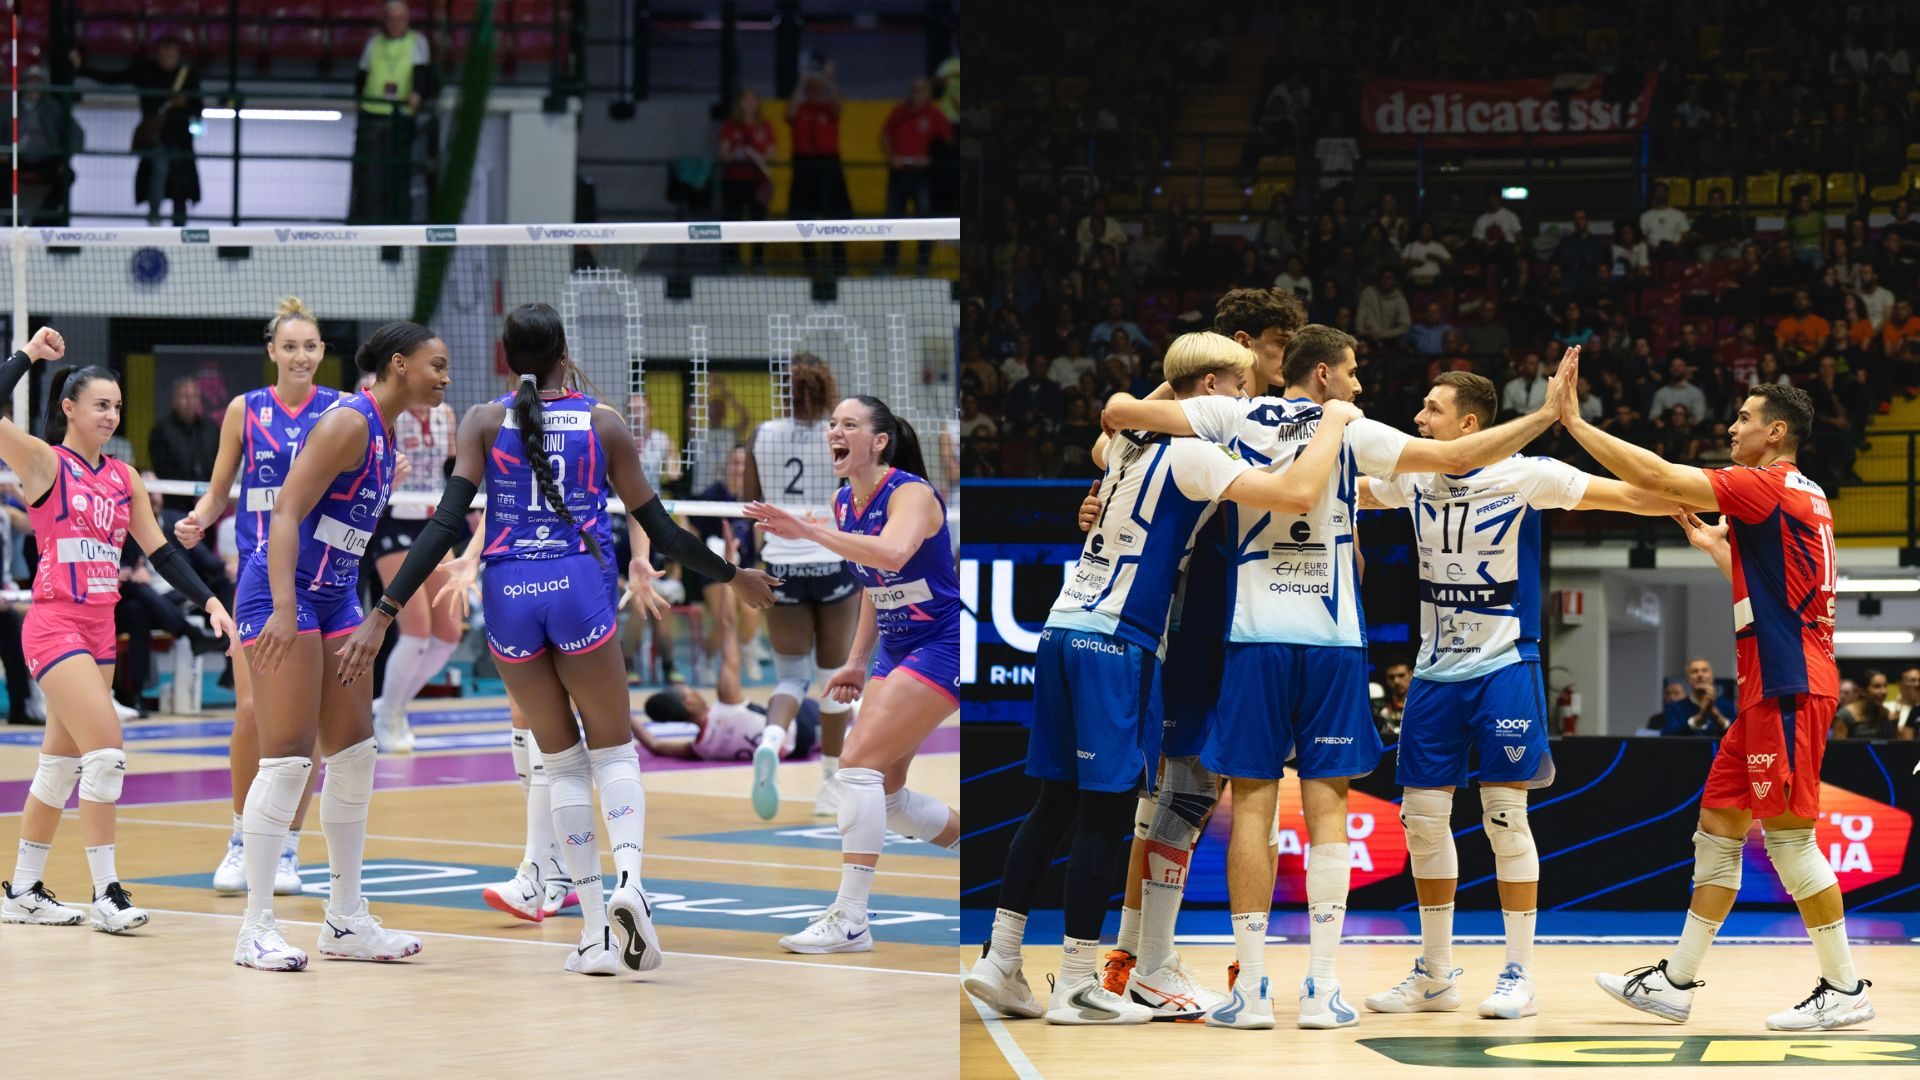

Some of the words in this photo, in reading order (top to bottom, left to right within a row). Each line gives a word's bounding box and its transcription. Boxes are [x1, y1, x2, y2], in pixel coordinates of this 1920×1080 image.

[542, 413, 578, 425] umia
[542, 433, 565, 452] ONU
[783, 457, 805, 495] 2
[93, 495, 115, 531] 80
[1475, 494, 1516, 516] FREDDY
[1441, 502, 1470, 554] 17
[1304, 561, 1328, 570] EURO
[503, 575, 570, 599] opiquad
[1269, 581, 1329, 595] opiquad
[1430, 586, 1496, 602] MINT
[1458, 621, 1483, 632] TXT
[559, 624, 608, 651] UNIKA
[1071, 637, 1125, 656] opiquad
[1314, 736, 1354, 745] FREDDY
[1076, 749, 1096, 760] EDDY
[613, 841, 642, 854] REDDY
